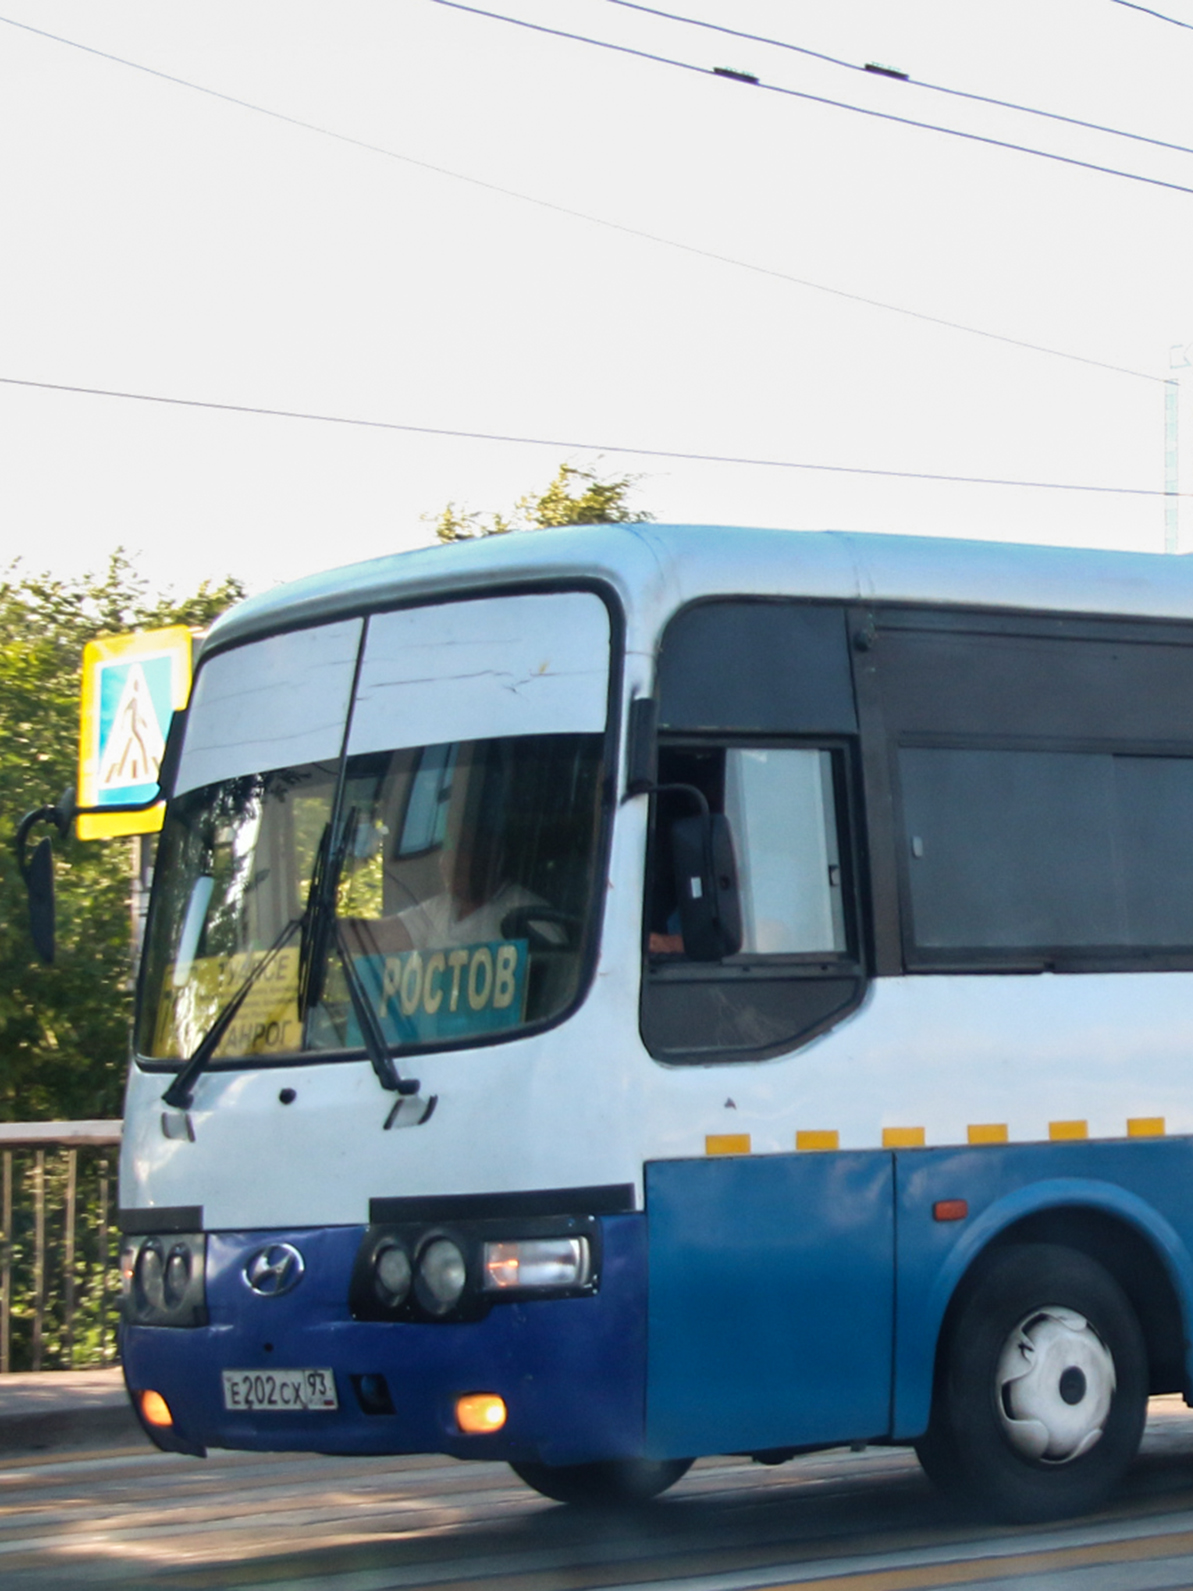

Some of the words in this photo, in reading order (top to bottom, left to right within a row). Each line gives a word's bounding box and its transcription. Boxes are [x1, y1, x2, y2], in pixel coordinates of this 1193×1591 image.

[378, 945, 518, 1018] РОСТОВ
[231, 1375, 302, 1405] Е202СХ
[307, 1372, 327, 1396] 93
